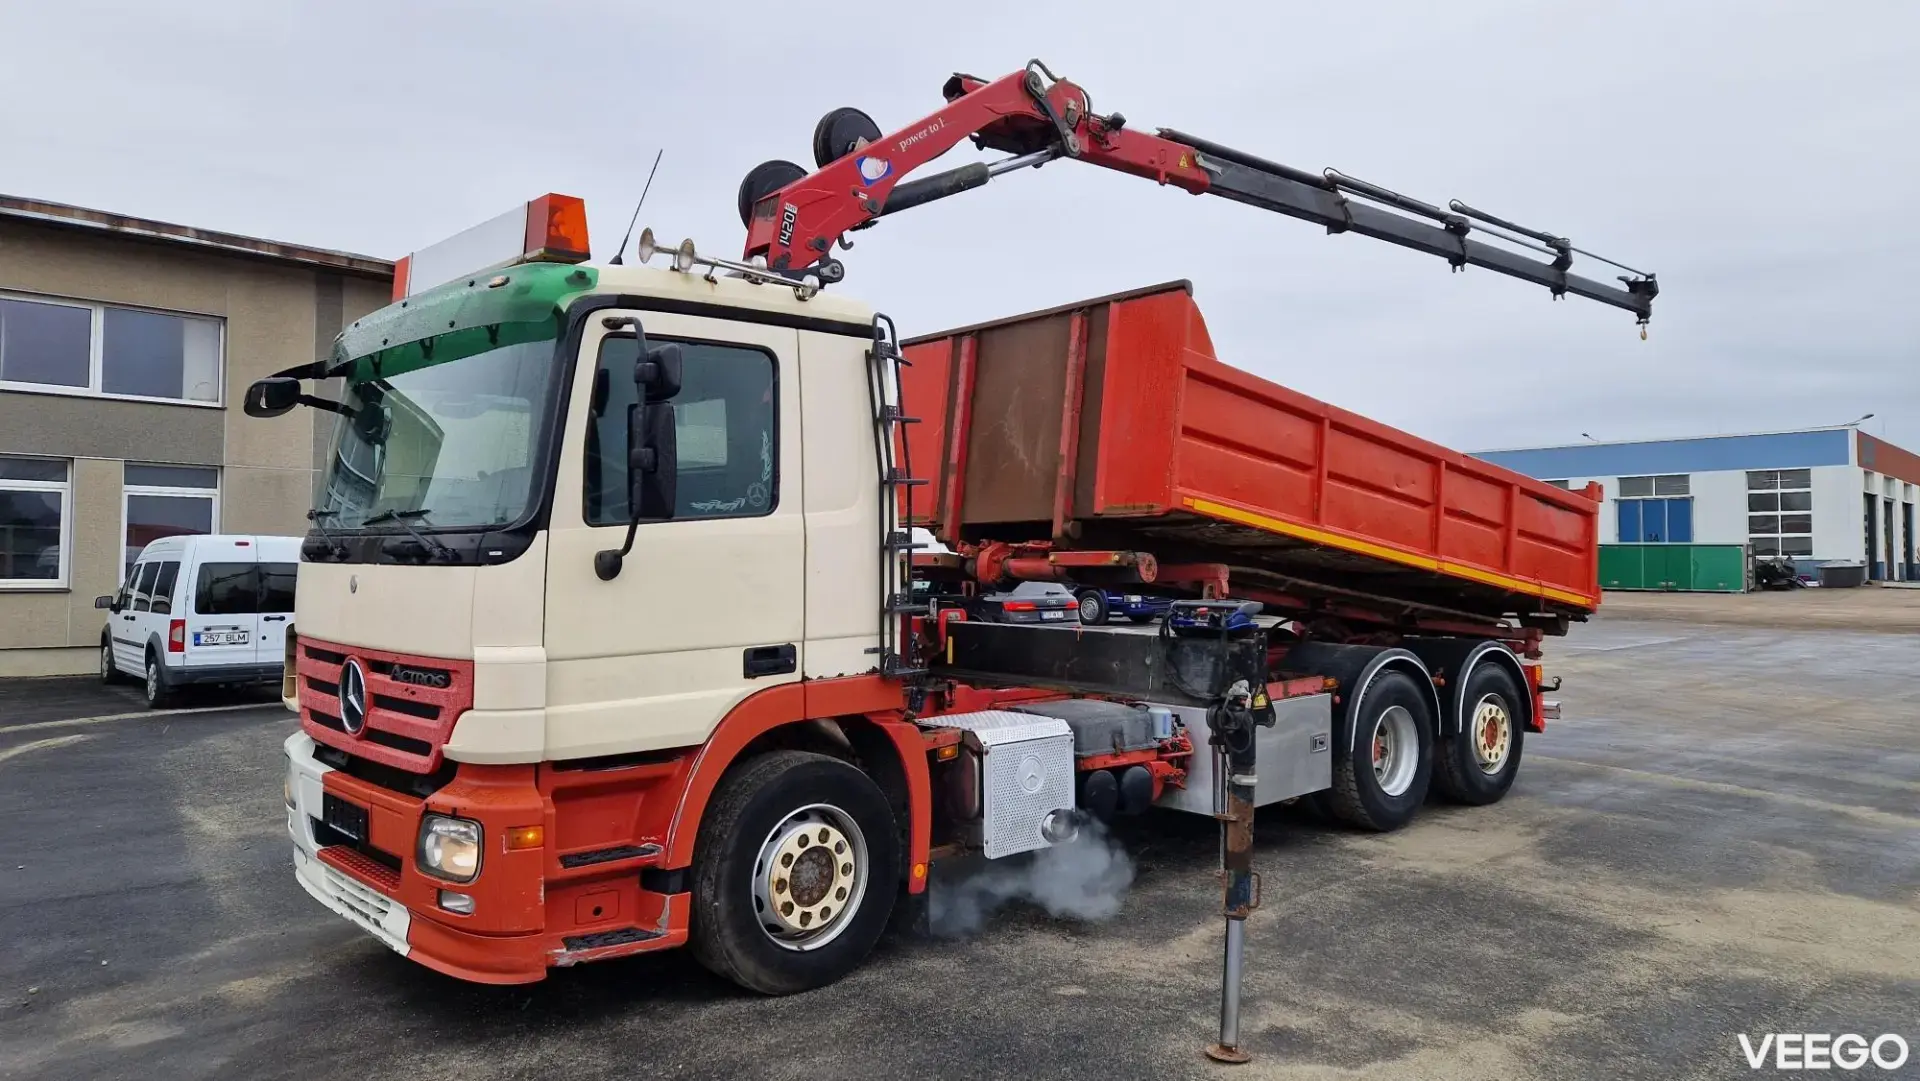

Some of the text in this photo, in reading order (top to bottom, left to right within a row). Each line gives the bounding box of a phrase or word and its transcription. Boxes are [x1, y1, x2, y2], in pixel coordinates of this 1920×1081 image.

[899, 128, 928, 153] power
[928, 123, 939, 134] to
[779, 212, 795, 246] 1420
[203, 633, 246, 643] 257 BLM
